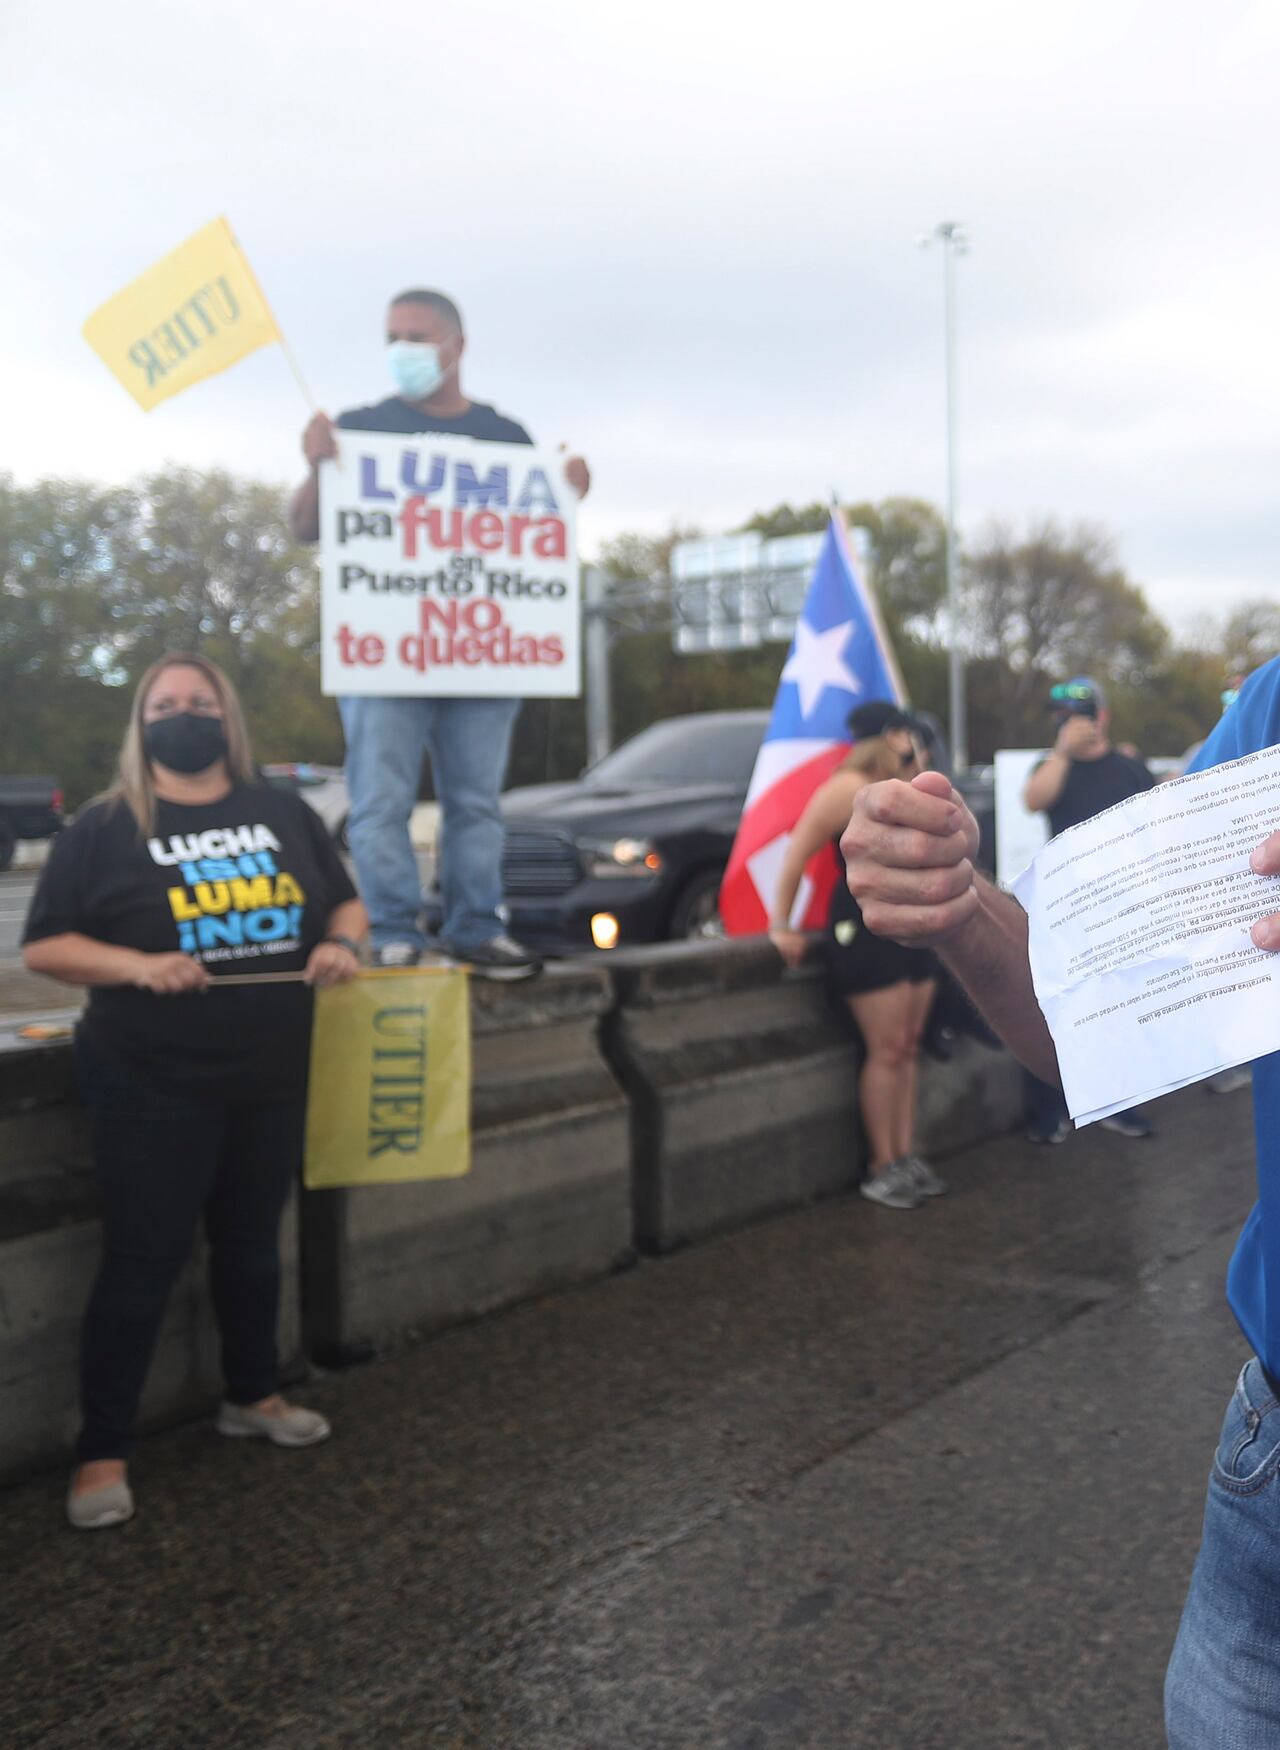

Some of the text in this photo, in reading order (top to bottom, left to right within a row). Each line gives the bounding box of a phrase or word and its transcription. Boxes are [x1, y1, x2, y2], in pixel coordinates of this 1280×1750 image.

[360, 451, 559, 512] LUMA
[336, 494, 567, 559] pa fuera
[451, 556, 482, 573] en
[340, 565, 566, 598] Puerto Rico
[420, 598, 502, 634] NO
[336, 625, 565, 674] te quedas
[1220, 755, 1259, 772] solicitamos
[1220, 783, 1239, 793] cosas
[1240, 778, 1255, 787] esas
[1186, 791, 1209, 804] pasen.
[1240, 789, 1255, 800] hizo
[1185, 796, 1228, 816] compromiso
[1157, 811, 1185, 825] durante
[147, 823, 281, 866] LUCHA
[1192, 834, 1221, 848] decenas
[1181, 843, 1225, 862] Industriales,
[1207, 852, 1235, 864] razones
[1235, 846, 1254, 857] otras
[1096, 868, 1121, 884] sociedad
[1117, 868, 1143, 886] expertos
[1158, 867, 1182, 880] centros
[1111, 877, 1149, 900] pensamiento
[1163, 884, 1202, 900] catástrofes
[1210, 887, 1227, 897] para
[1228, 881, 1253, 894] utilizar
[1250, 887, 1269, 898] inicio
[167, 872, 305, 921] LUMA
[1098, 894, 1112, 904] como
[1145, 895, 1162, 906] como
[1181, 892, 1210, 906] arreglar
[1260, 896, 1279, 907] tiene
[1117, 903, 1145, 920] huracanes
[1193, 905, 1208, 914] casi
[1214, 900, 1260, 920] compromiso
[1154, 912, 1180, 927] millones
[176, 904, 304, 953] ¡NO!
[1174, 919, 1232, 942] Puertorriqueños
[1219, 951, 1236, 960] para
[1237, 945, 1259, 957] LUMA
[1193, 957, 1219, 969] Puerto
[1247, 954, 1264, 964] gran
[1196, 961, 1247, 980] incertidumbre
[1166, 976, 1186, 991] pueblo
[1237, 975, 1271, 991] Narrativa
[1151, 986, 1166, 996] tiene
[1191, 993, 1207, 1004] sobre
[1208, 984, 1237, 999] general
[1126, 995, 1141, 1007] saber
[1161, 1001, 1186, 1016] contrato
[1137, 1013, 1154, 1025] LUMA
[367, 1004, 427, 1160] UTIER
